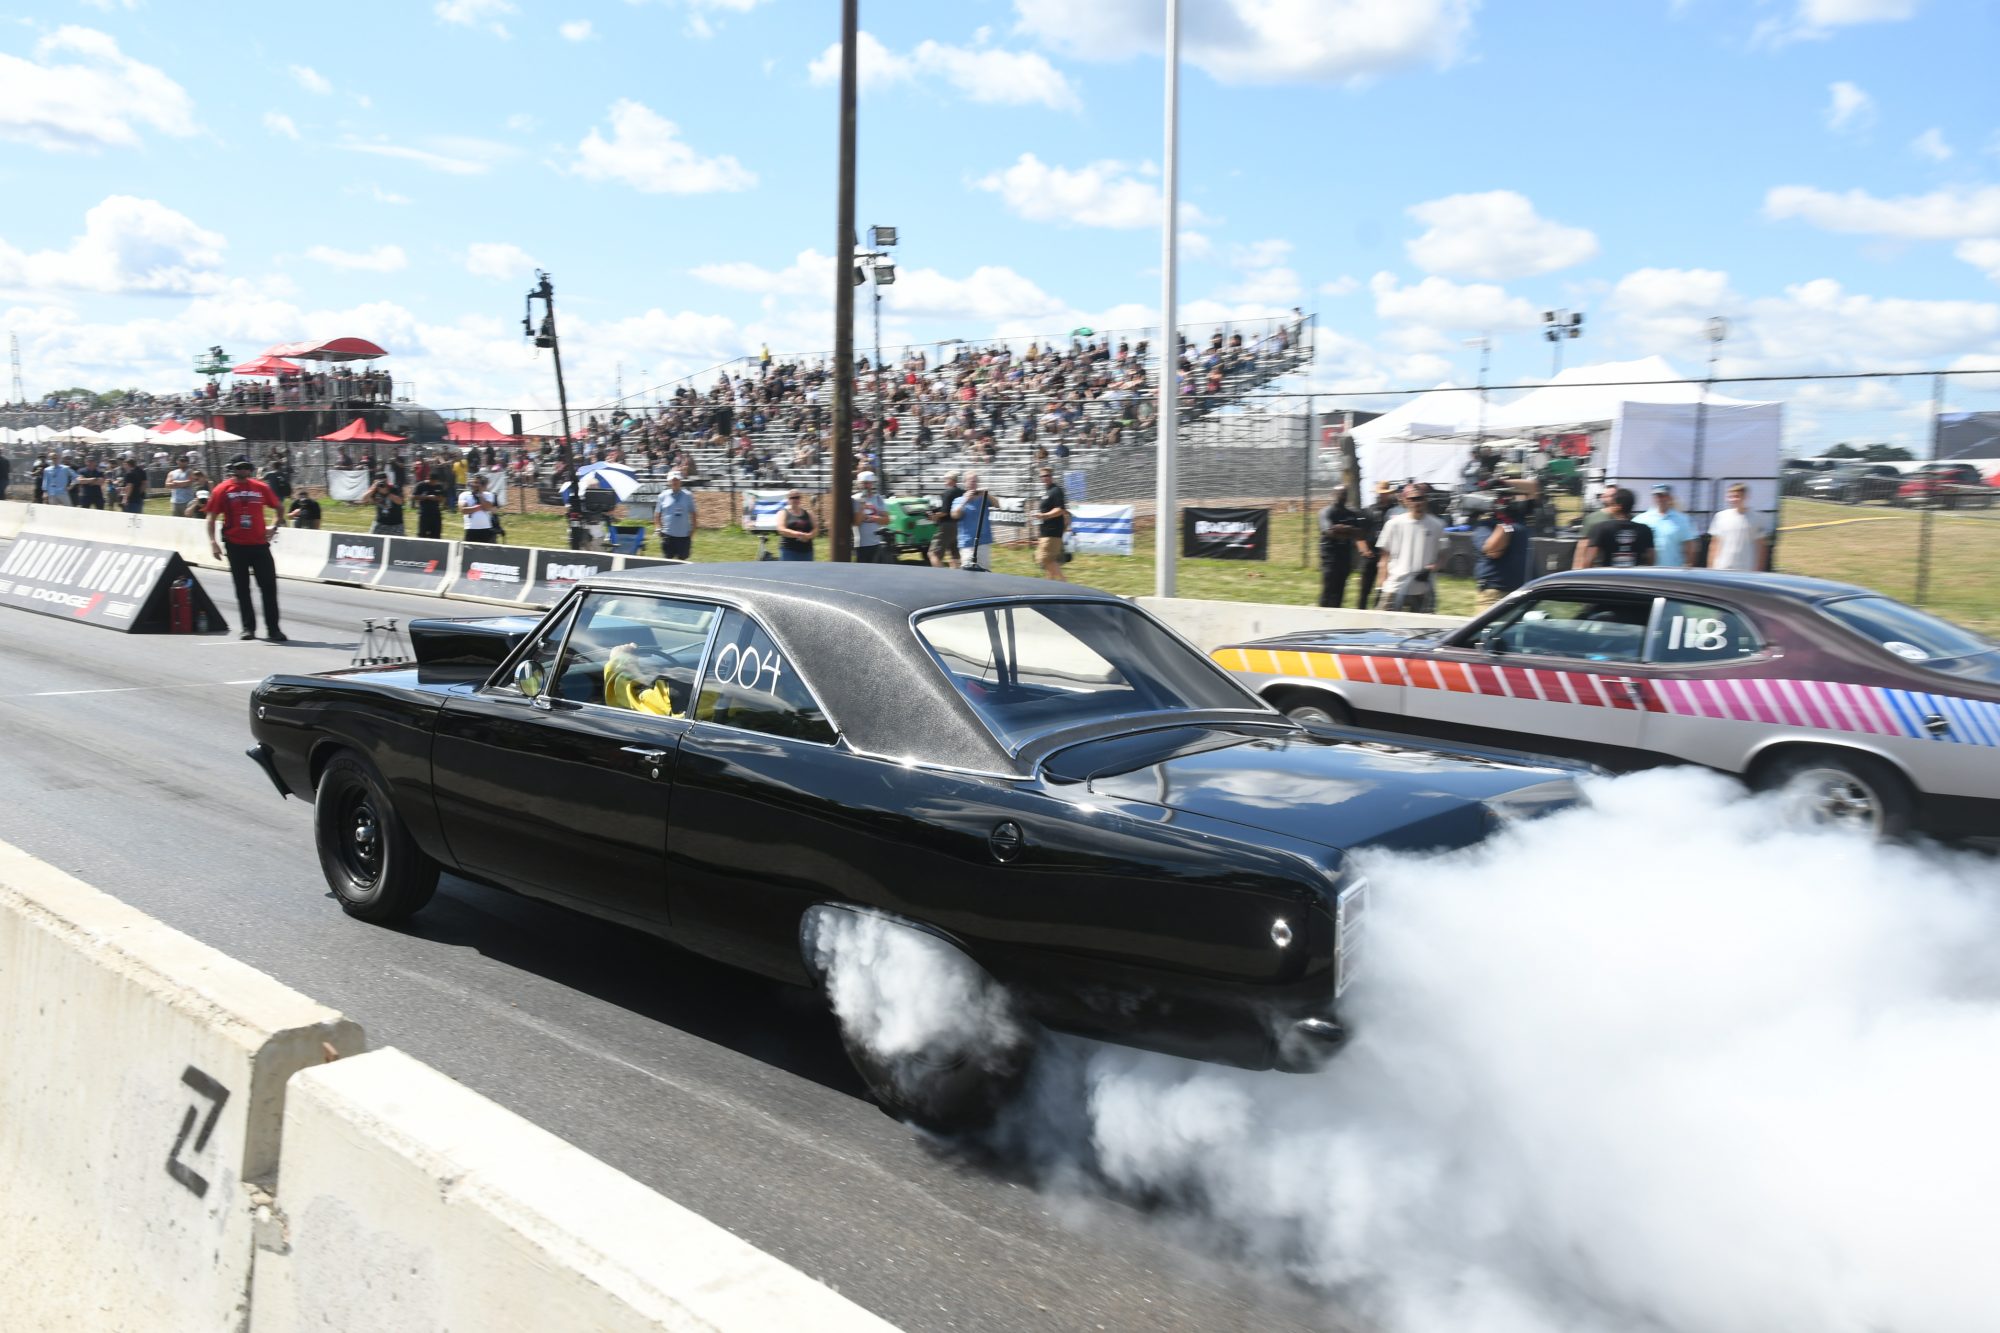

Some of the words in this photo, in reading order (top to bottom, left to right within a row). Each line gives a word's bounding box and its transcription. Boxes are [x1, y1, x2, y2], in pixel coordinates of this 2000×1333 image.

[31, 587, 94, 609] DODGE
[1667, 615, 1729, 651] 118
[714, 642, 782, 697] 004
